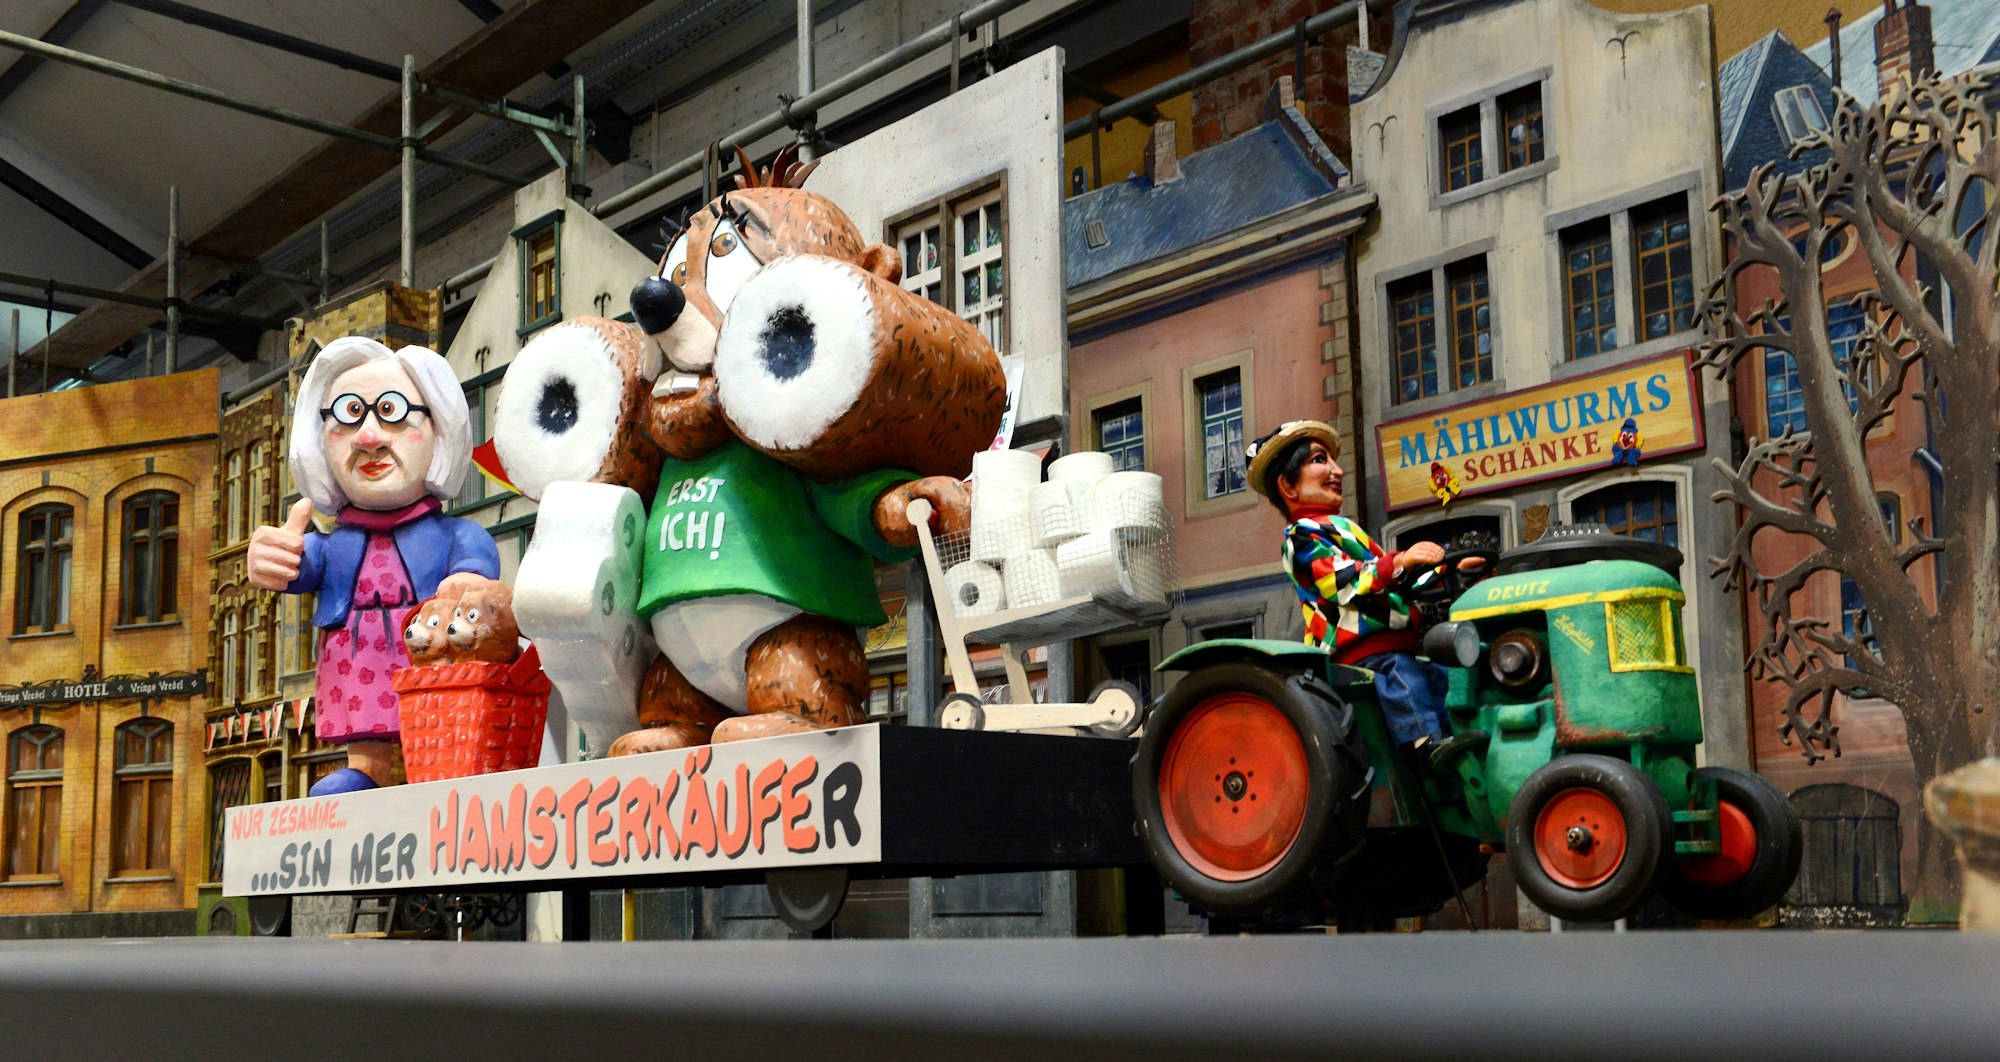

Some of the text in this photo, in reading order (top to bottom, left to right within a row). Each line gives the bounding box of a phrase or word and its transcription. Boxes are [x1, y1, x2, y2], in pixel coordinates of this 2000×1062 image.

[1399, 373, 1671, 469] MÄHLWURMS
[1463, 431, 1601, 482] SCHÄNKE
[666, 477, 726, 507] ERST
[660, 510, 726, 560] ICH!
[1487, 580, 1550, 602] DEUTZ
[64, 683, 110, 699] HOTEL
[231, 808, 264, 841] NUR
[251, 746, 863, 892] ...SIN MER HAMSTERKÄUFER
